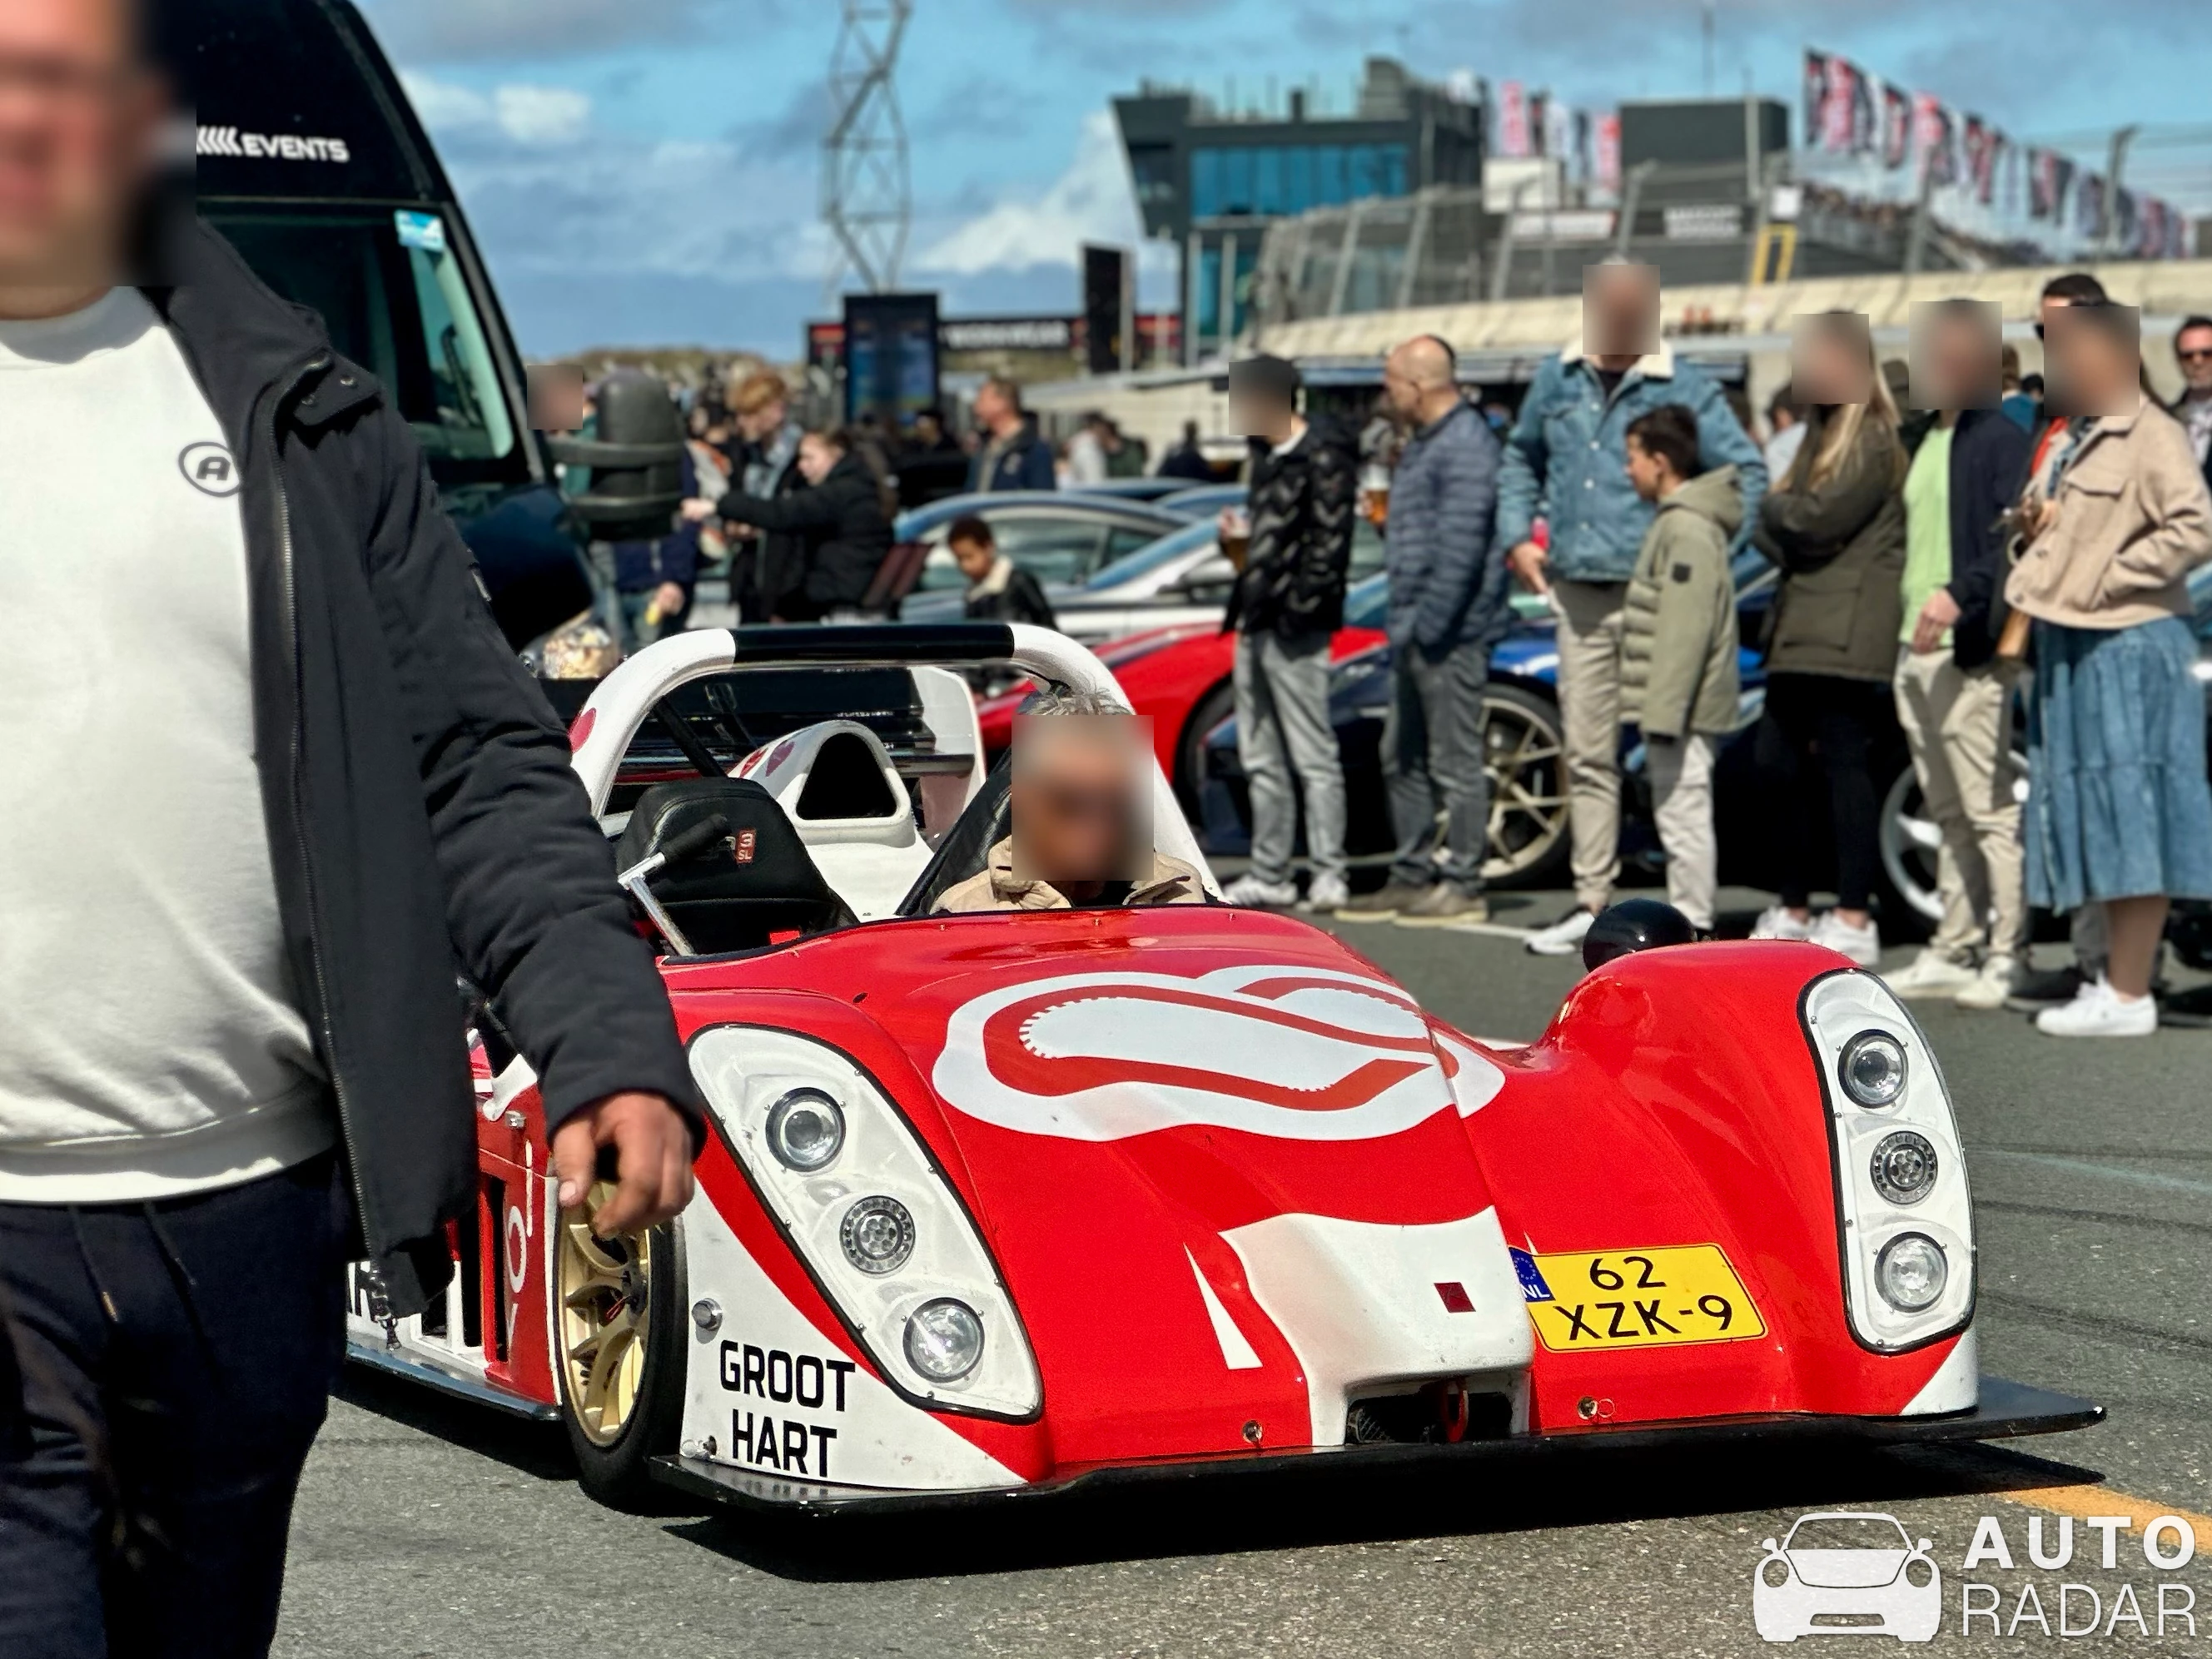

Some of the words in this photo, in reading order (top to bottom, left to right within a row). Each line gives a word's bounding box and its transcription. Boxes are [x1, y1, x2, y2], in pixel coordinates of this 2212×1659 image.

[241, 133, 350, 162] EVENTS
[196, 456, 231, 481] A
[1589, 1255, 1668, 1291] 62
[1521, 1284, 1550, 1299] NL
[1552, 1294, 1732, 1341] XZK-9
[720, 1339, 856, 1412] GROOT
[732, 1408, 838, 1478] HART
